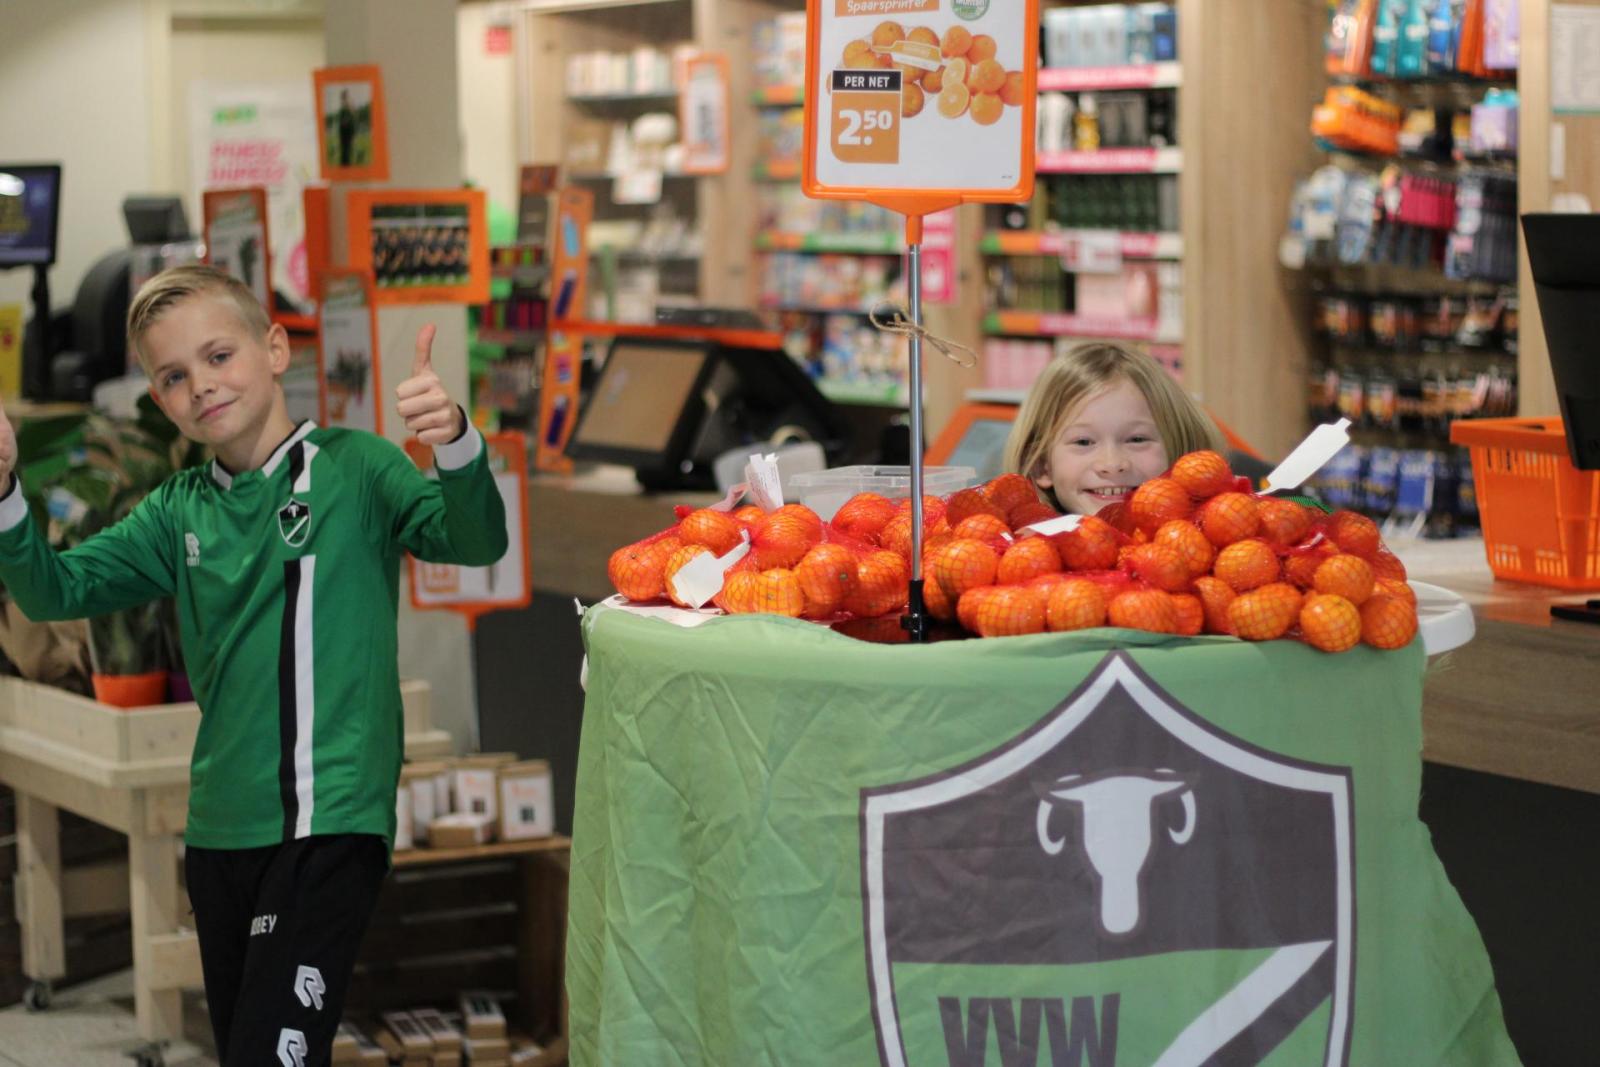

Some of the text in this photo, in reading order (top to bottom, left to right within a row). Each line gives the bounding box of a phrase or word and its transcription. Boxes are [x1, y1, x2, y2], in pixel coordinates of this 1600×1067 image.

[844, 76, 890, 88] PER NET
[838, 109, 893, 146] 2.50
